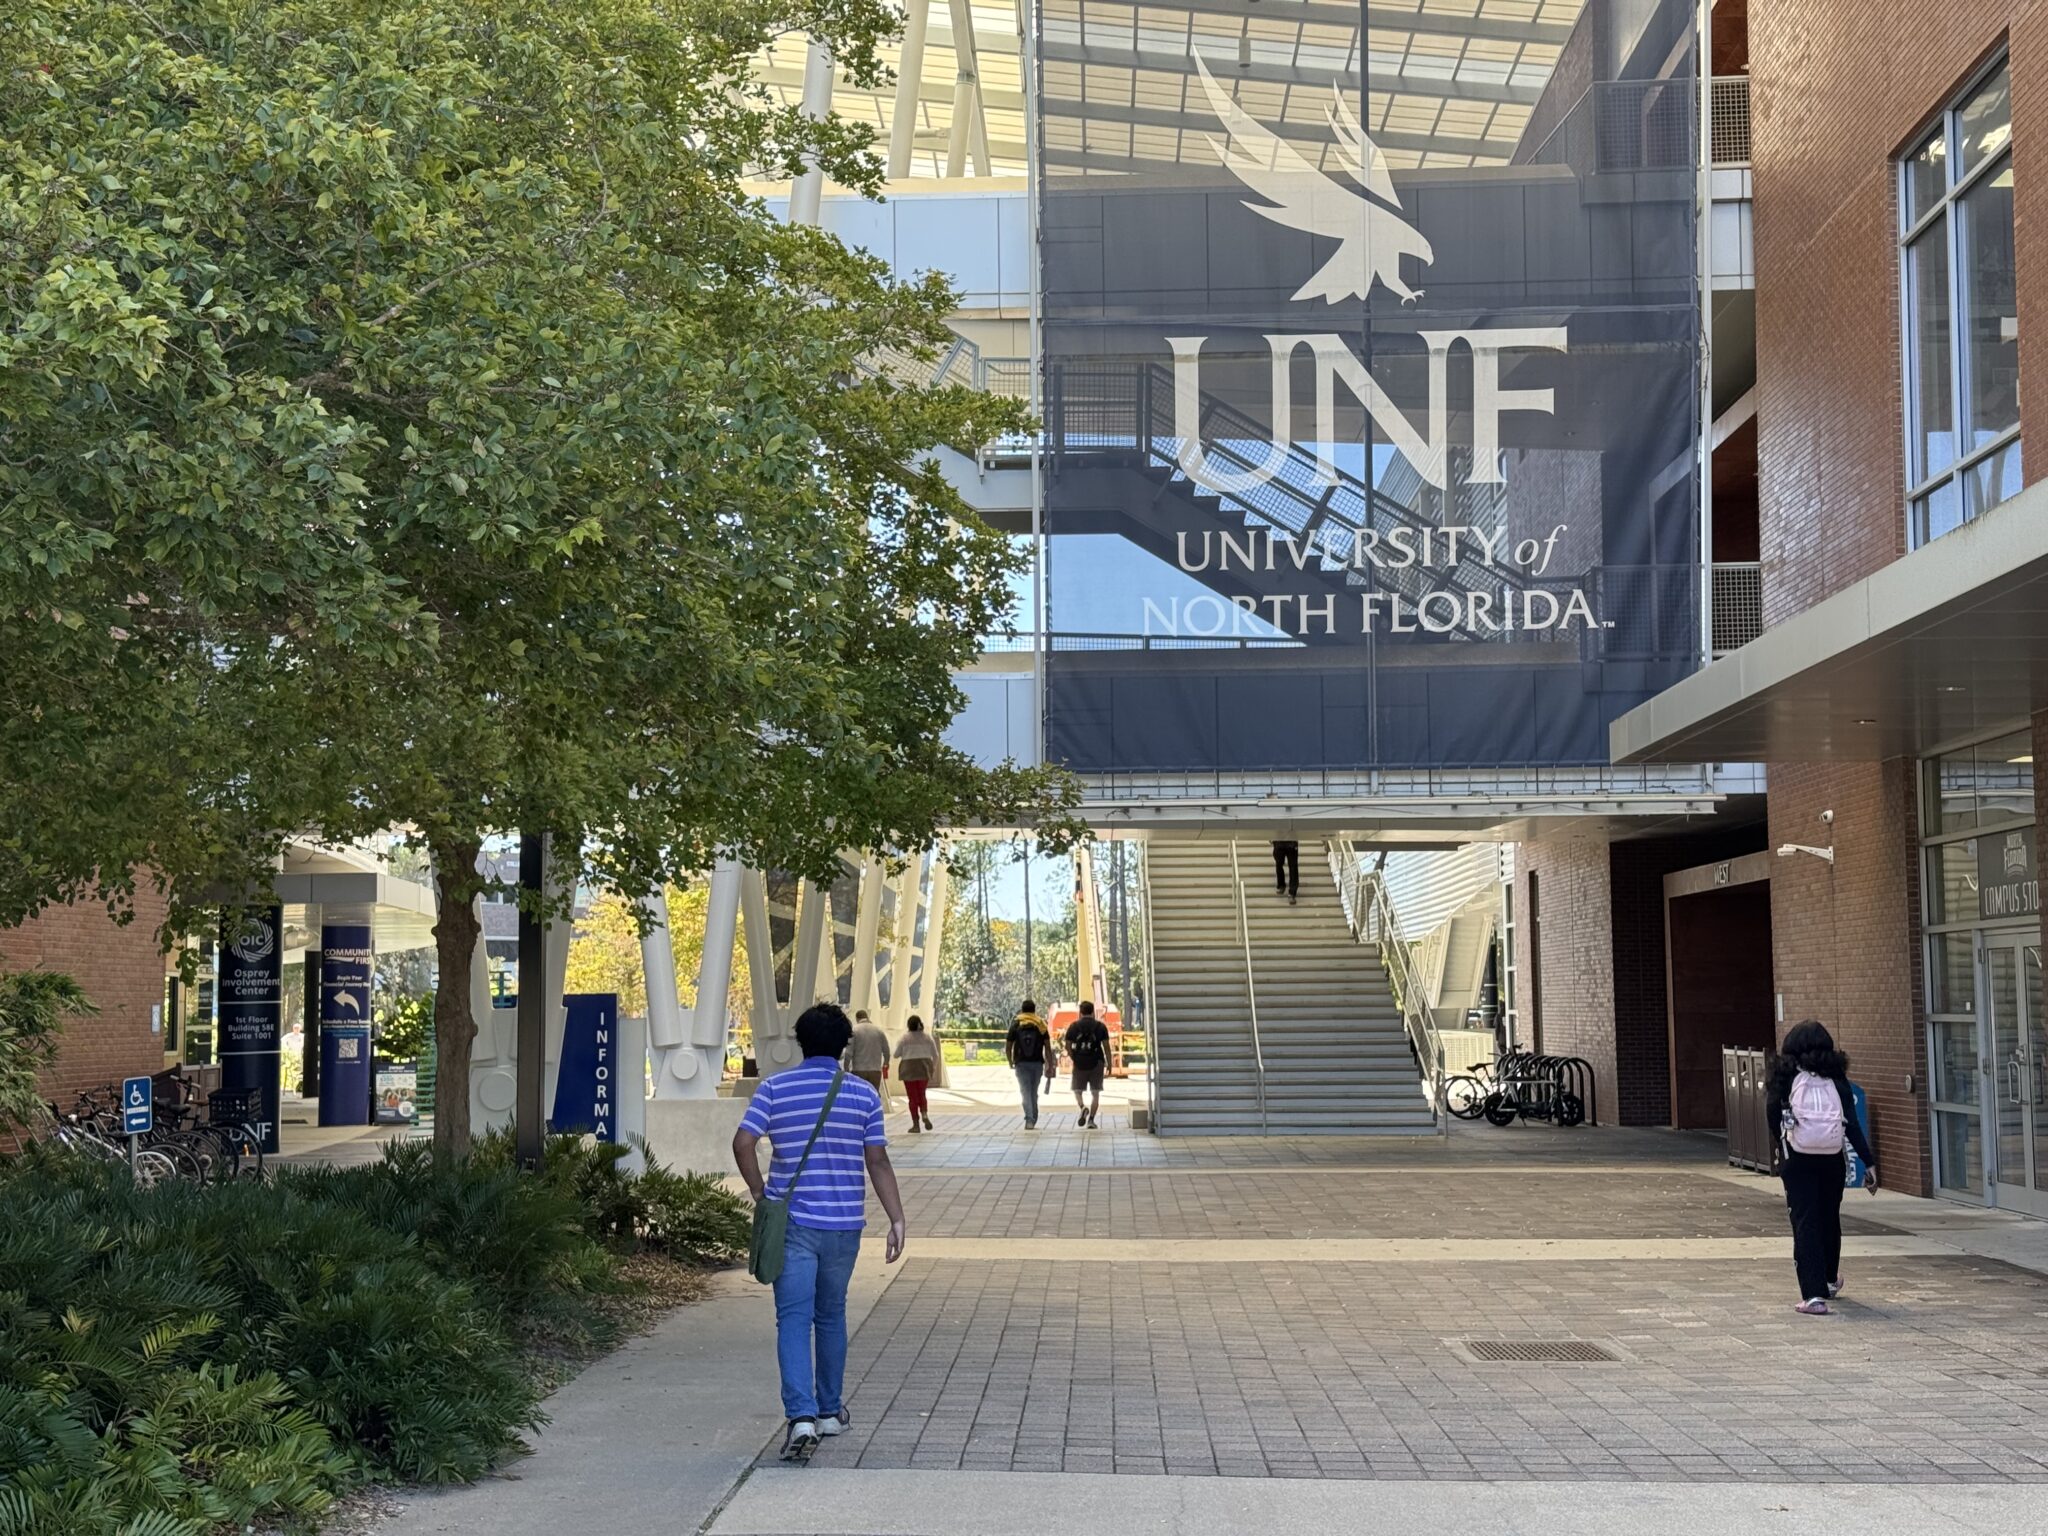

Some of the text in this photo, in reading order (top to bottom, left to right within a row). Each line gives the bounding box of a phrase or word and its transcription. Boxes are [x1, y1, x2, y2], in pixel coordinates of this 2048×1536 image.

[1164, 325, 1568, 493] UNF
[1176, 524, 1568, 577] UNIVERSITY of
[1141, 593, 1335, 638] NORTH
[1361, 588, 1600, 635] FLORIDA
[1713, 862, 1729, 885] WEST
[1984, 880, 2039, 916] CAMPUS STO
[239, 935, 264, 946] OIC
[324, 948, 371, 957] COMMUNIT
[355, 956, 371, 965] FIRS
[234, 968, 270, 979] Osprey
[222, 977, 280, 988] Involvement
[235, 987, 269, 995] Center
[248, 1015, 268, 1023] Floor
[227, 1024, 260, 1032] Building
[231, 1032, 272, 1040] Suite 1001
[594, 1012, 609, 1142] INFORMA
